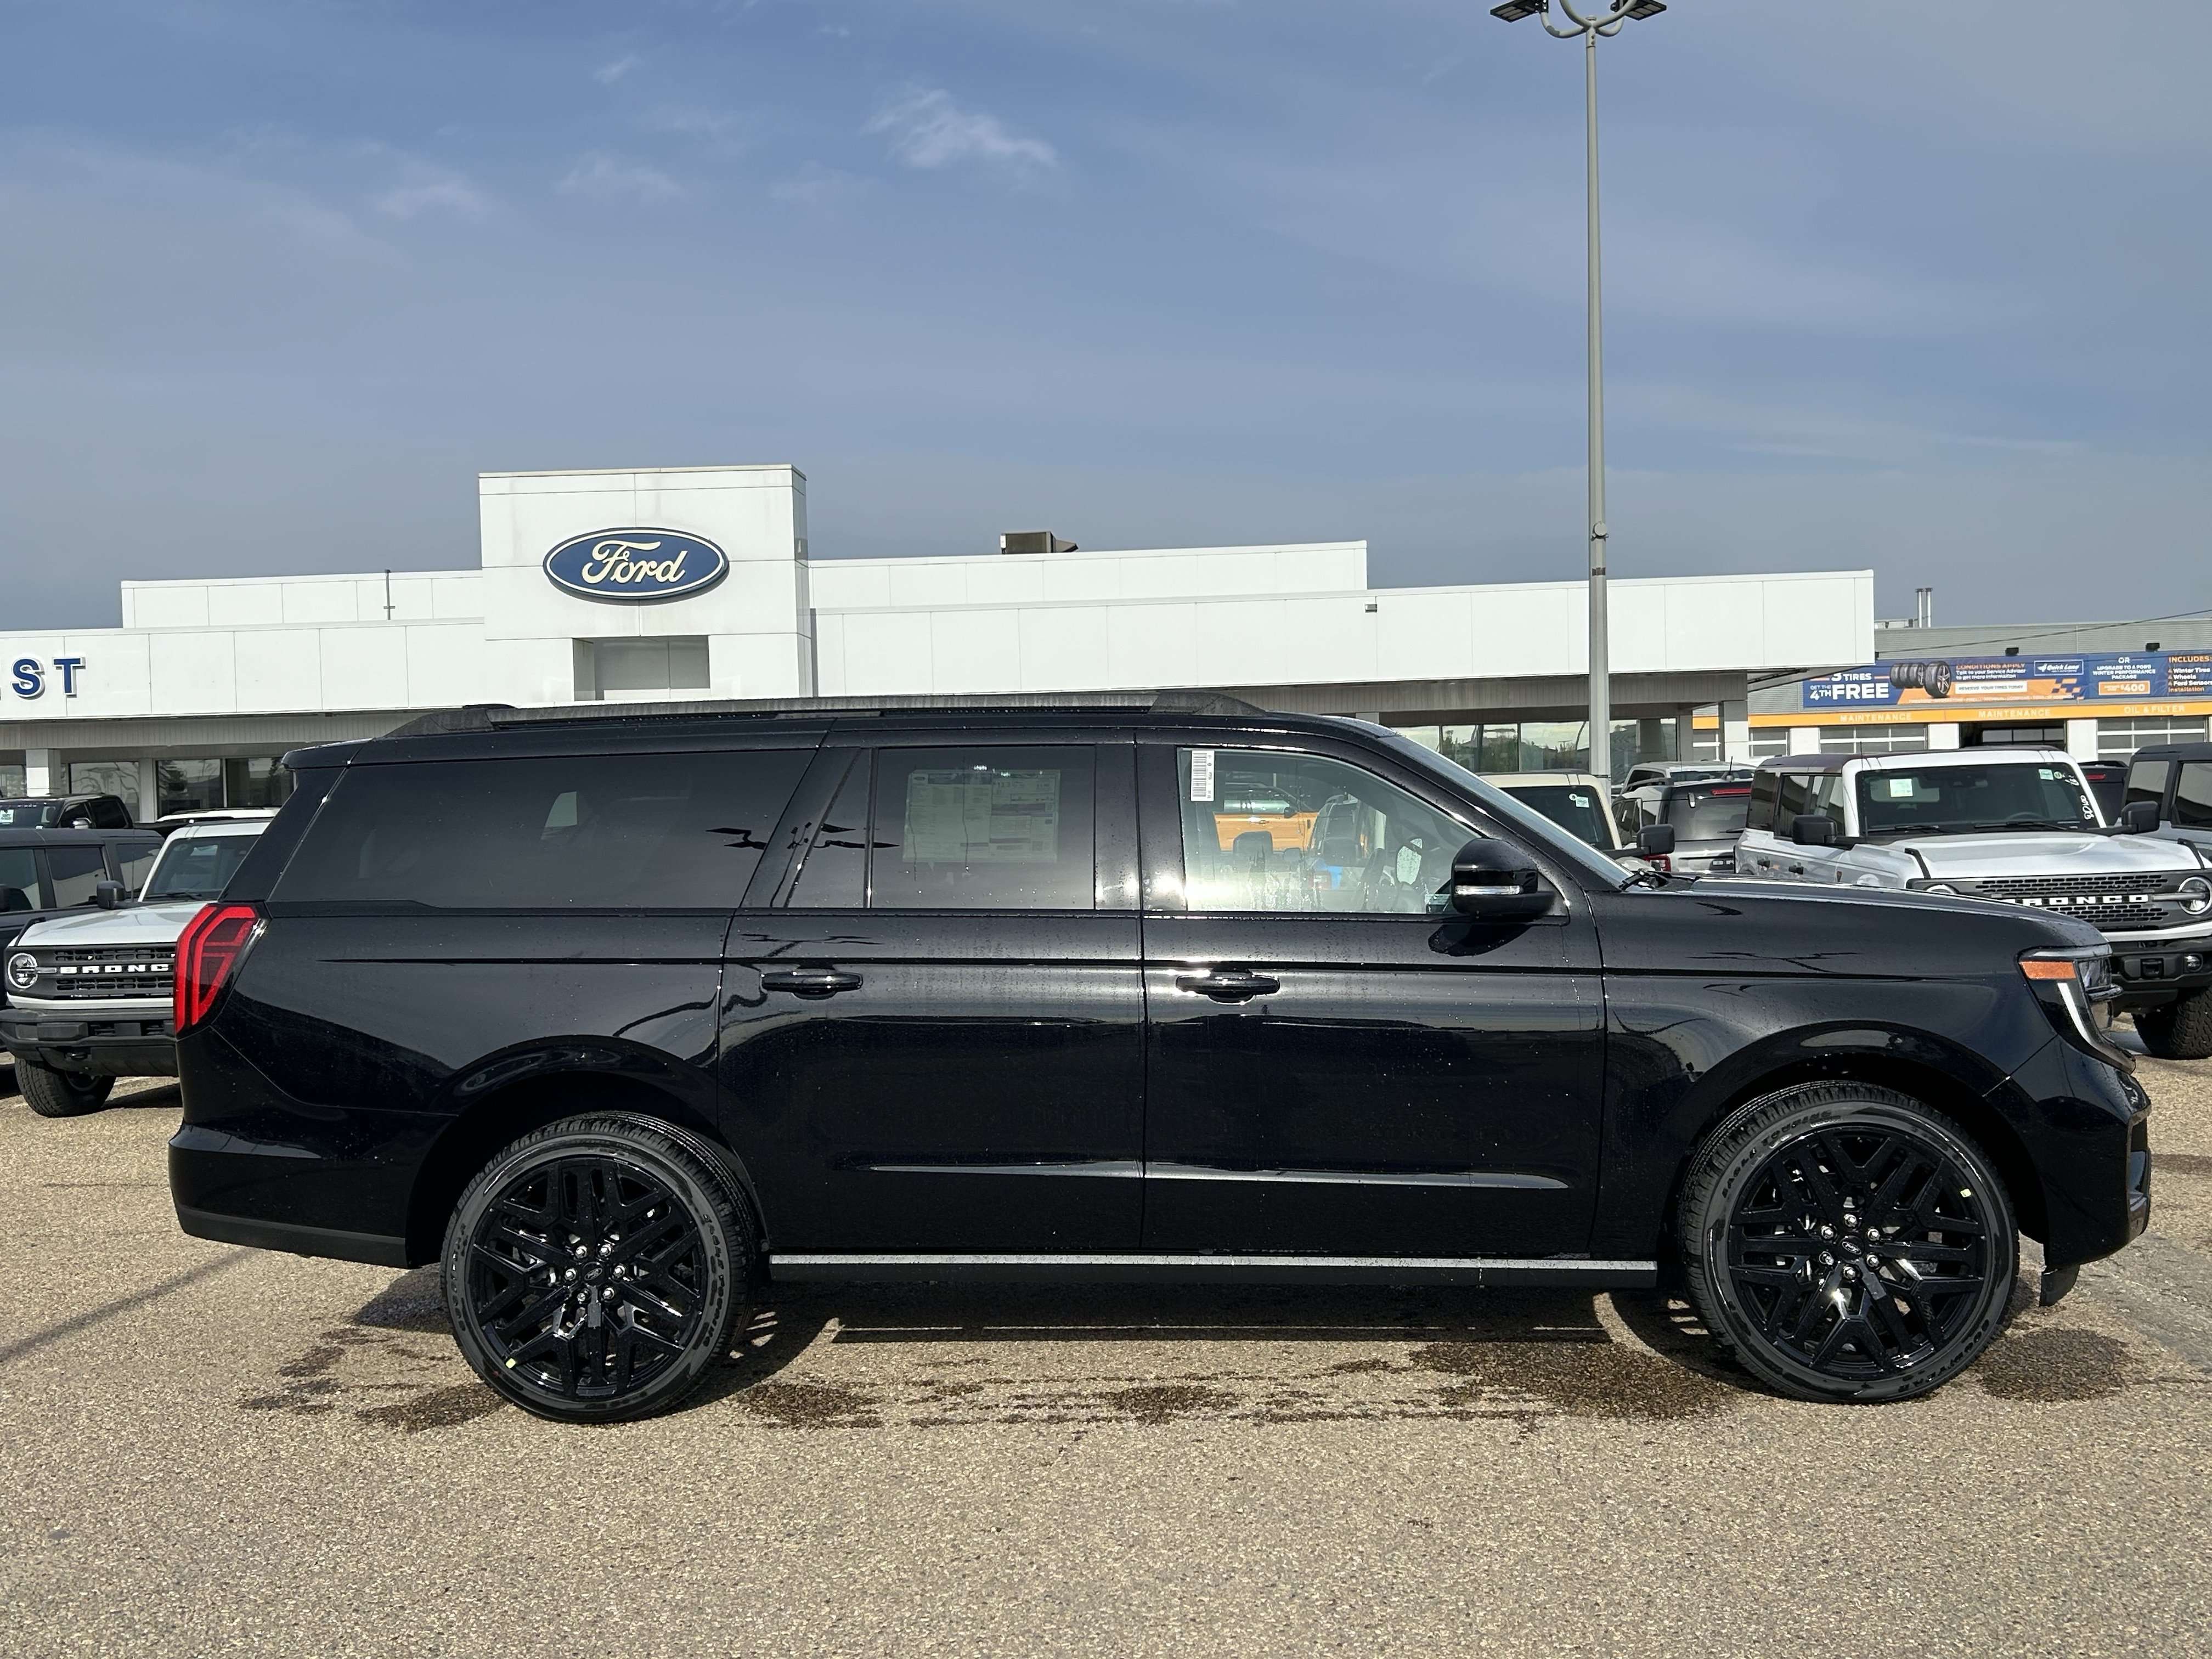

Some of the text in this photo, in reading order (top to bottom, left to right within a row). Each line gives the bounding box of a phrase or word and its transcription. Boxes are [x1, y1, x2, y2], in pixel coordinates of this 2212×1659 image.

[582, 540, 688, 584] Ford
[9, 657, 85, 698] ST
[1831, 673, 1872, 681] 3 TIRES
[1810, 682, 1889, 701] 4TH FREE
[1978, 709, 2051, 718] MAINTENANCE
[2151, 704, 2185, 713] FILTER
[1839, 713, 1912, 723] MAINTENANCE
[60, 963, 169, 974] BRONC
